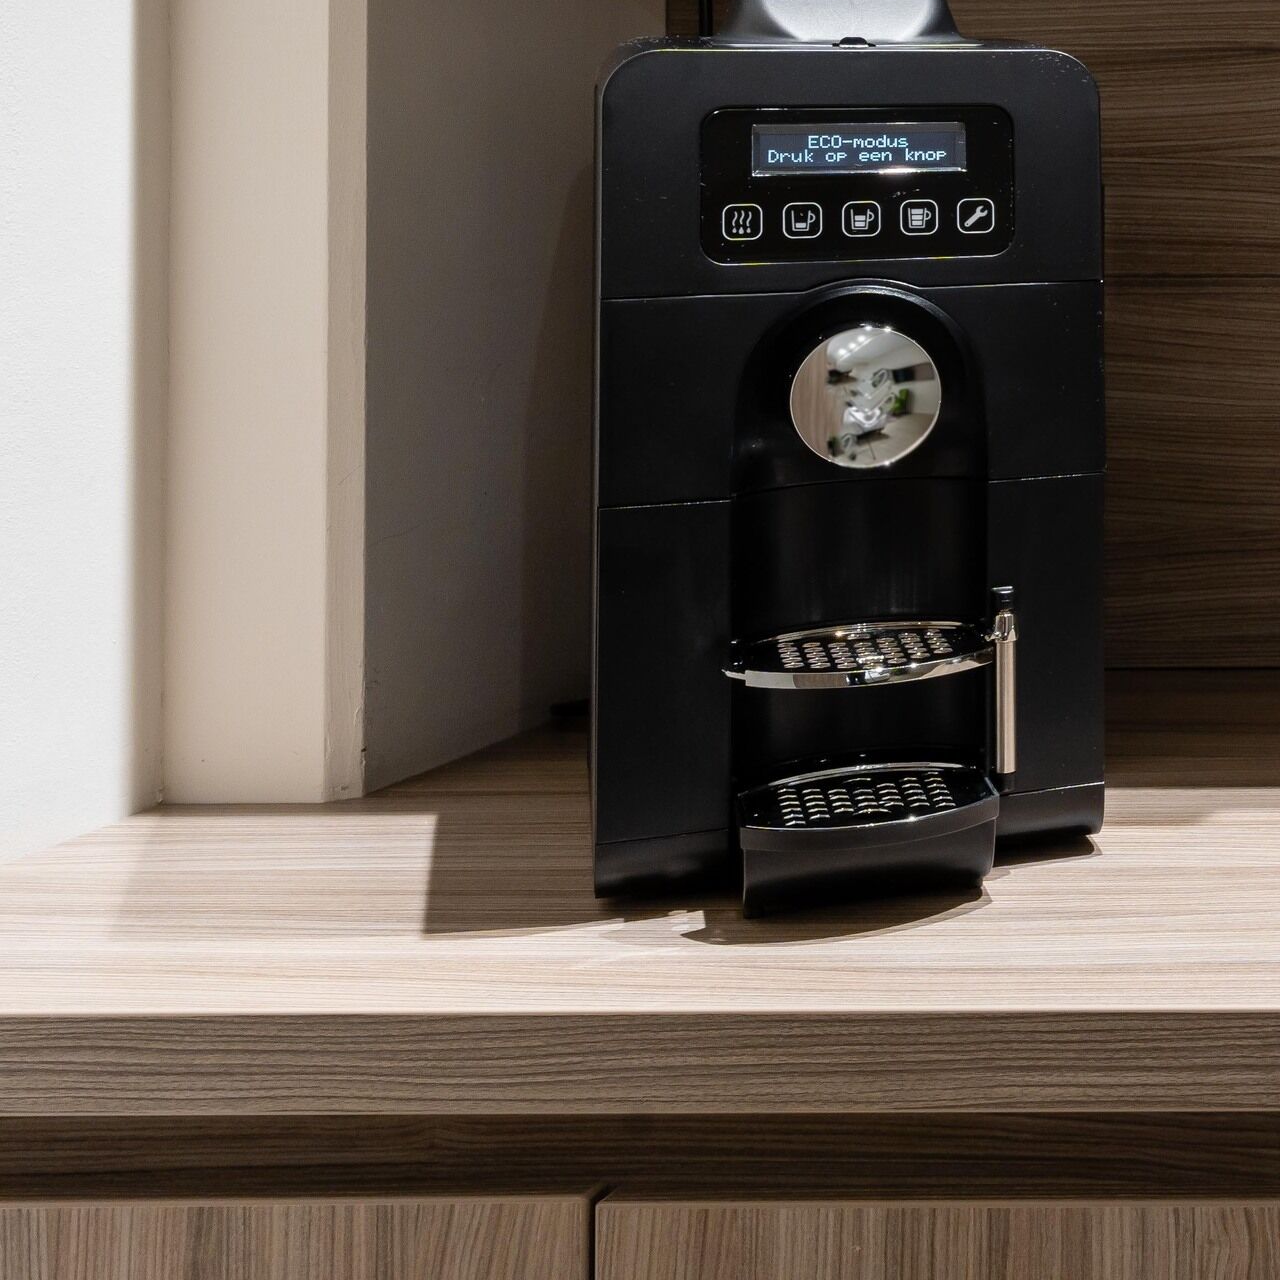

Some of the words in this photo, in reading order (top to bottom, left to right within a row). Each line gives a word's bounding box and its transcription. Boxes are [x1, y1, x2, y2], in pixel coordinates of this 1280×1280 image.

[807, 134, 909, 149] ECO-modus
[767, 149, 814, 164] Druk
[825, 151, 848, 163] op
[858, 150, 893, 162] een
[904, 147, 948, 162] knop
